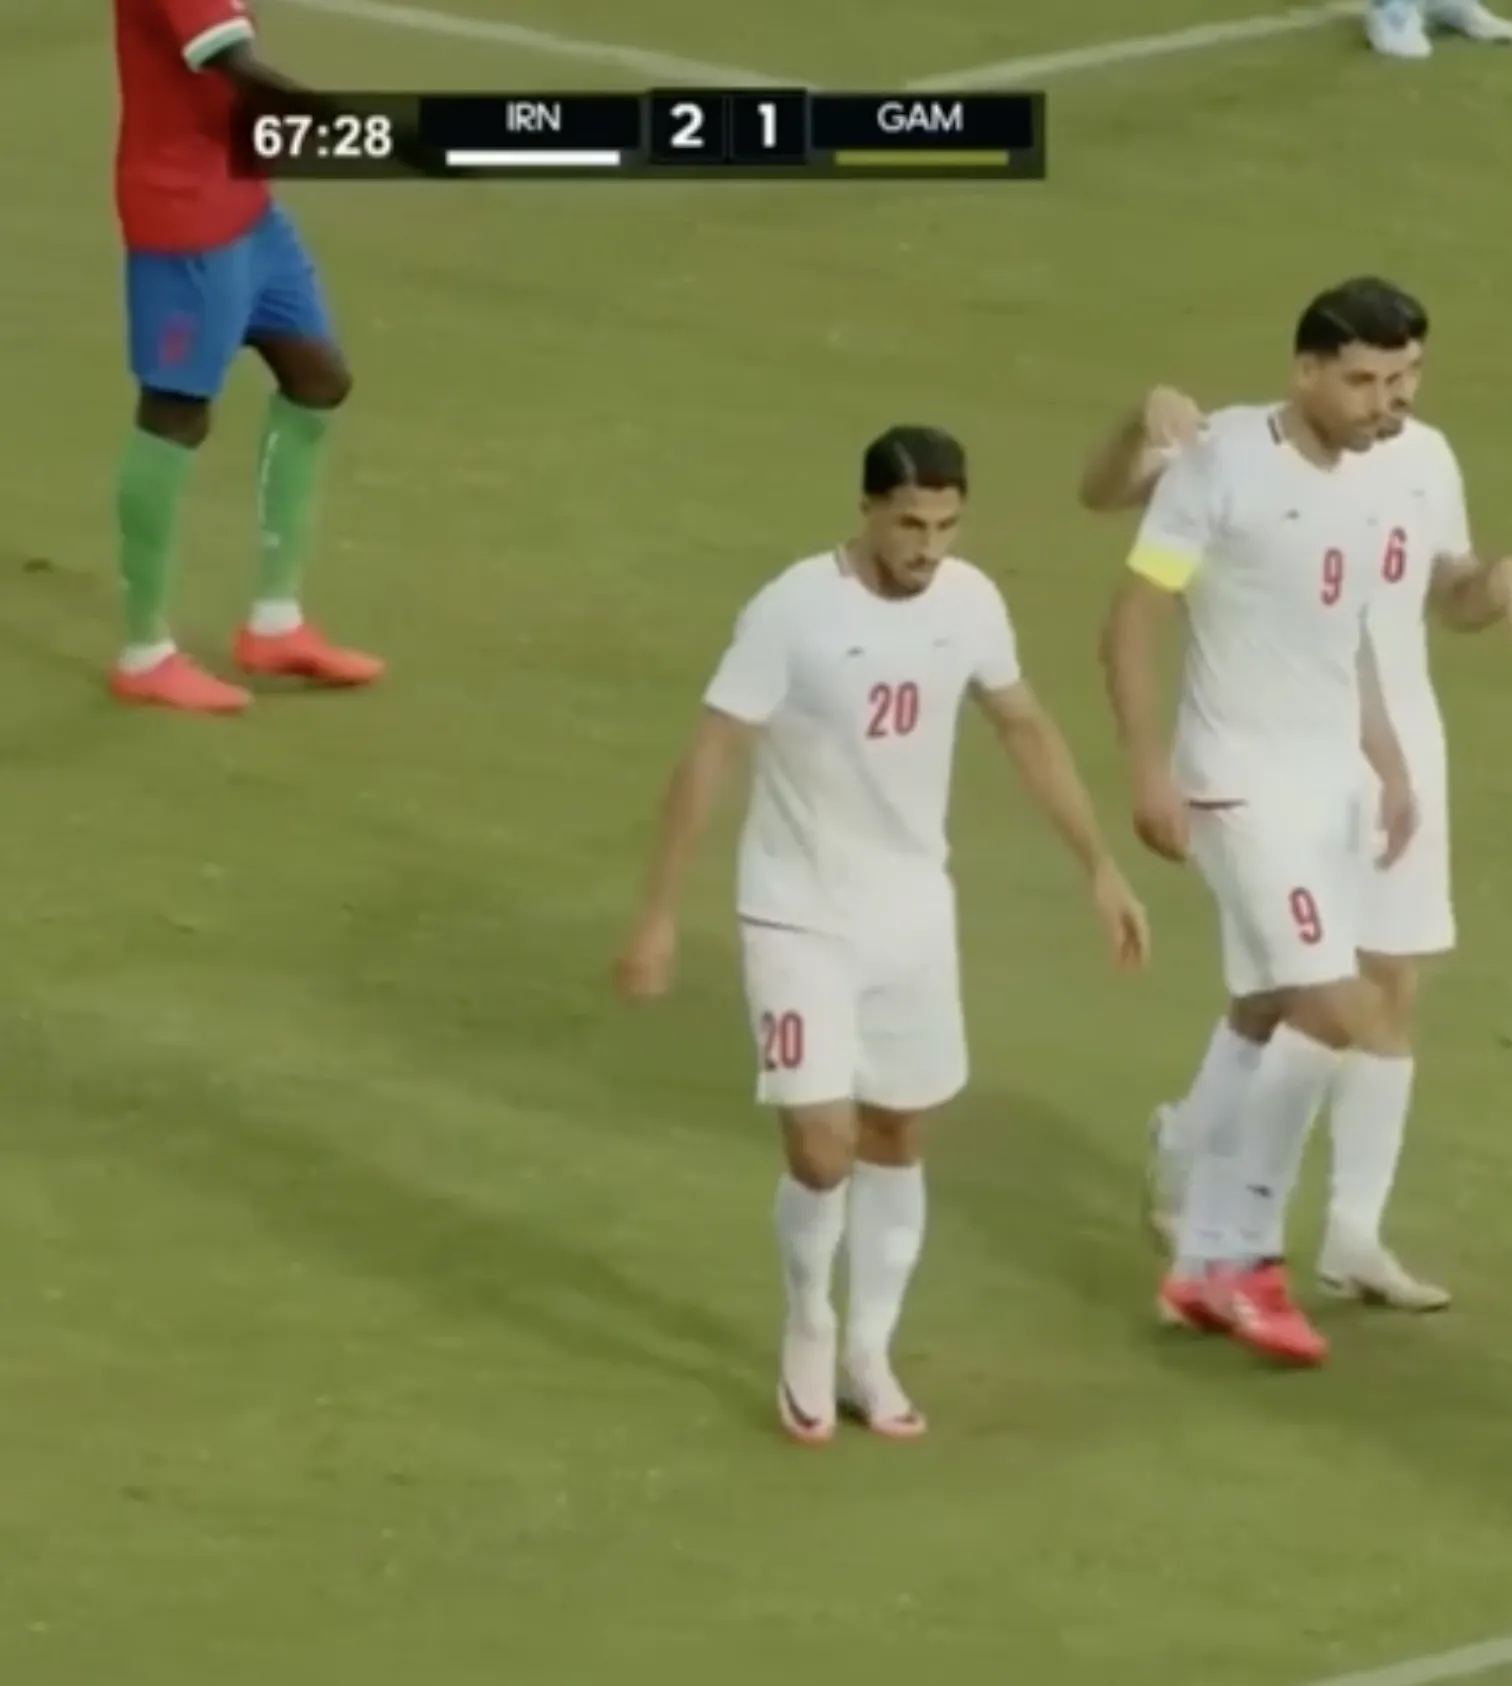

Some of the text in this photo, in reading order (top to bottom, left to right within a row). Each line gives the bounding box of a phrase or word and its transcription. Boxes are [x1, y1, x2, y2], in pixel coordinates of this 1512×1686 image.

[1321, 548, 1344, 606] 9
[1382, 526, 1407, 583] 6
[865, 681, 921, 738] 20
[1289, 887, 1323, 944] 9
[760, 1010, 804, 1072] 20
